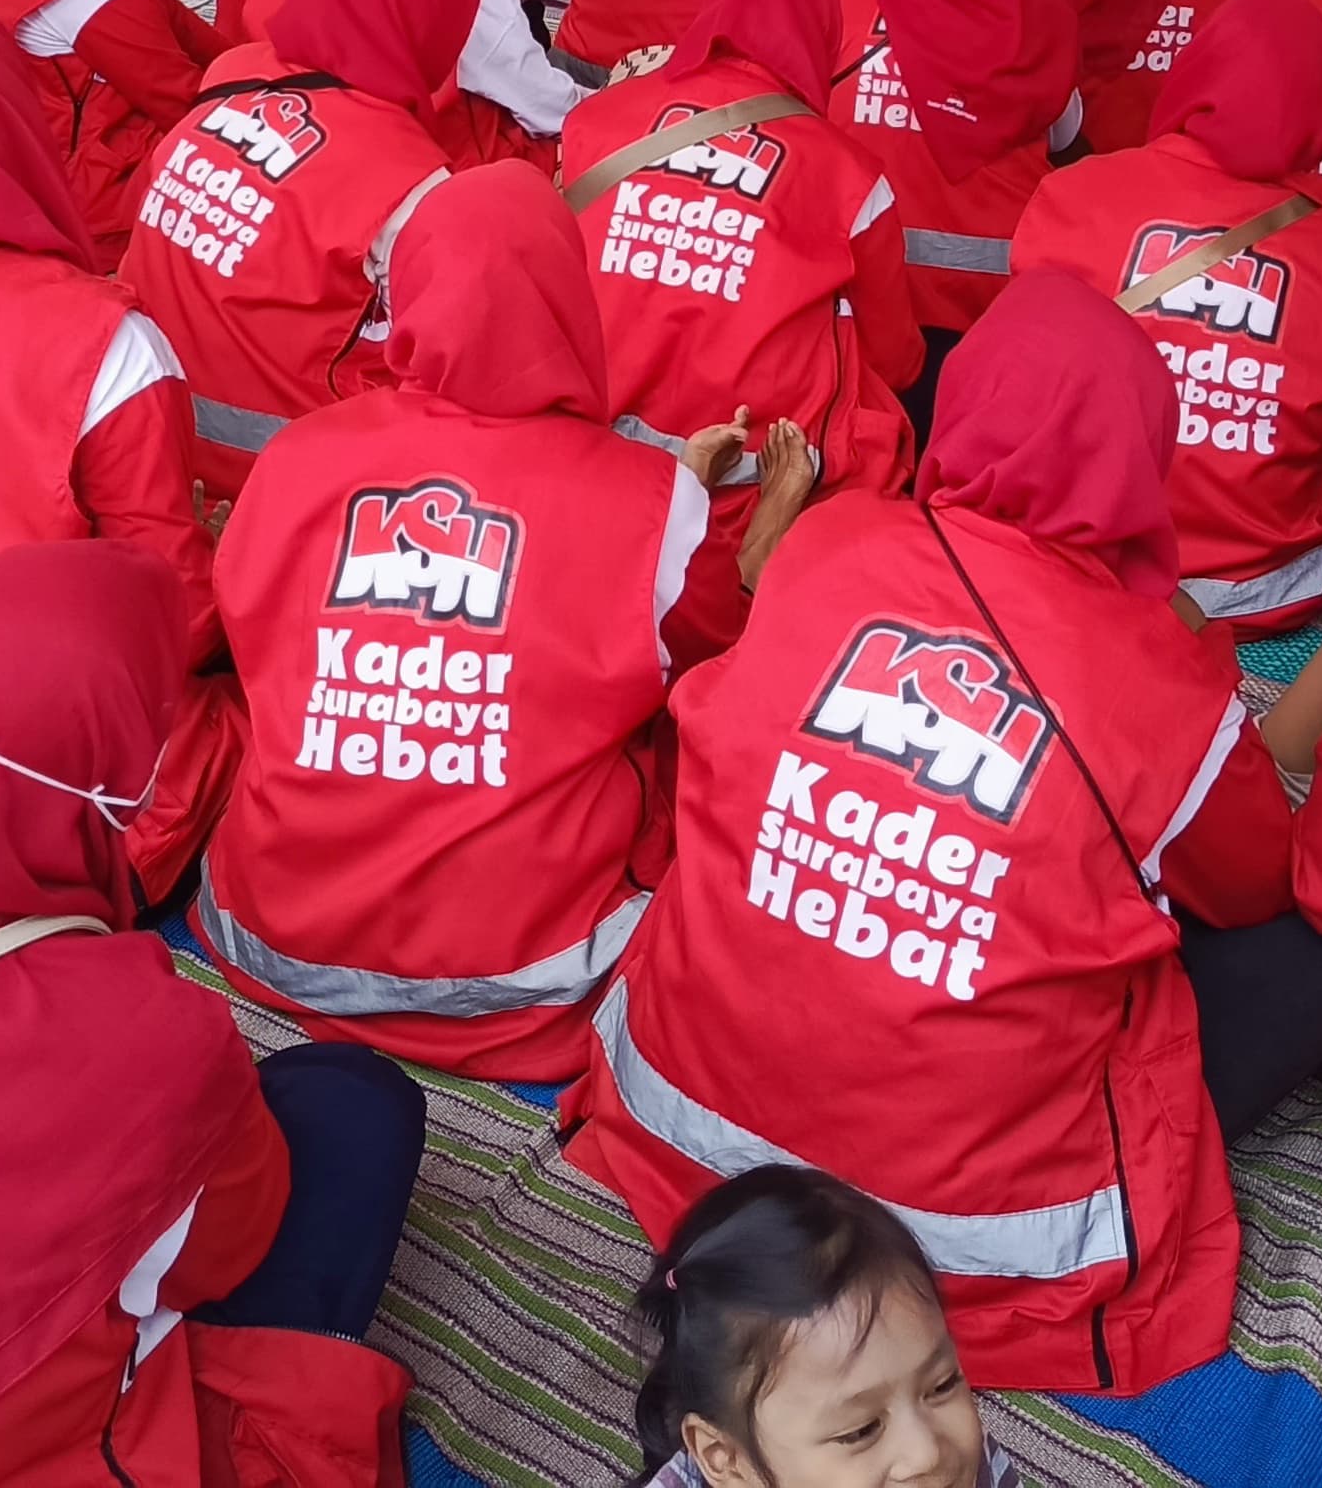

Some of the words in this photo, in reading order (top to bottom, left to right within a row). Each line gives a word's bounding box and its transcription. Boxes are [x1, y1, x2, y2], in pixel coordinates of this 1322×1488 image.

[152, 169, 260, 247] Surabaya
[165, 138, 275, 224] Kader
[613, 181, 765, 242] Kader
[139, 189, 244, 278] Hebat
[608, 215, 755, 266] Surabaya
[600, 238, 746, 302] Hebat
[1156, 342, 1285, 394] ader
[1177, 402, 1276, 455] bat
[317, 627, 513, 694] Kader
[307, 680, 510, 737] Surabaya
[295, 717, 508, 788] Hebat
[766, 750, 1011, 898] Kader
[757, 809, 997, 941] Surabaya
[747, 848, 986, 1001] Hebat
